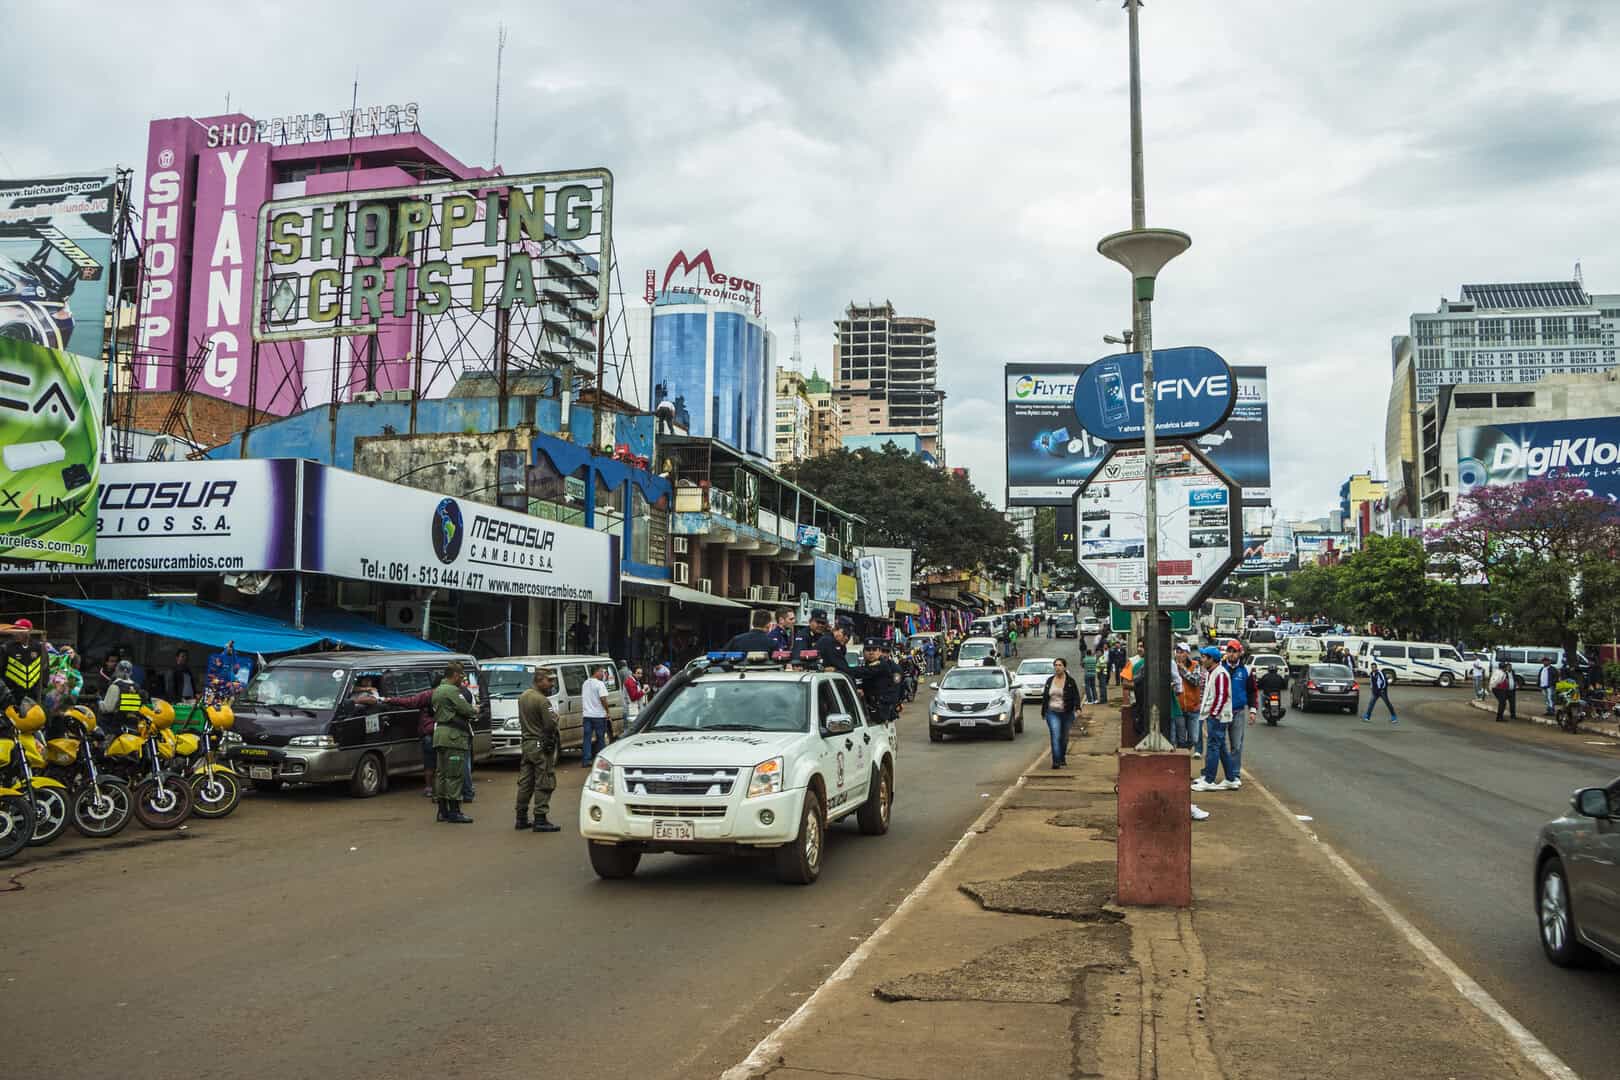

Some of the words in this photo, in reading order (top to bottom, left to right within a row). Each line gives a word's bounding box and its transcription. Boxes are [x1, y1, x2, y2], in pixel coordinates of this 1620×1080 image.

[207, 113, 326, 148] SHOPPING
[271, 184, 593, 265] SHOPPING
[307, 251, 538, 323] CRISTA
[662, 248, 755, 298] Mega
[37, 494, 87, 518] LINK
[470, 515, 554, 551] MERCOSUR
[470, 544, 534, 566] CAMBIOS
[361, 558, 386, 580] Tel.:
[389, 561, 409, 582] 061
[419, 566, 438, 585] 513
[441, 568, 458, 588] 444
[467, 573, 484, 590] 477
[488, 577, 593, 600] www.mercosurcambios.com
